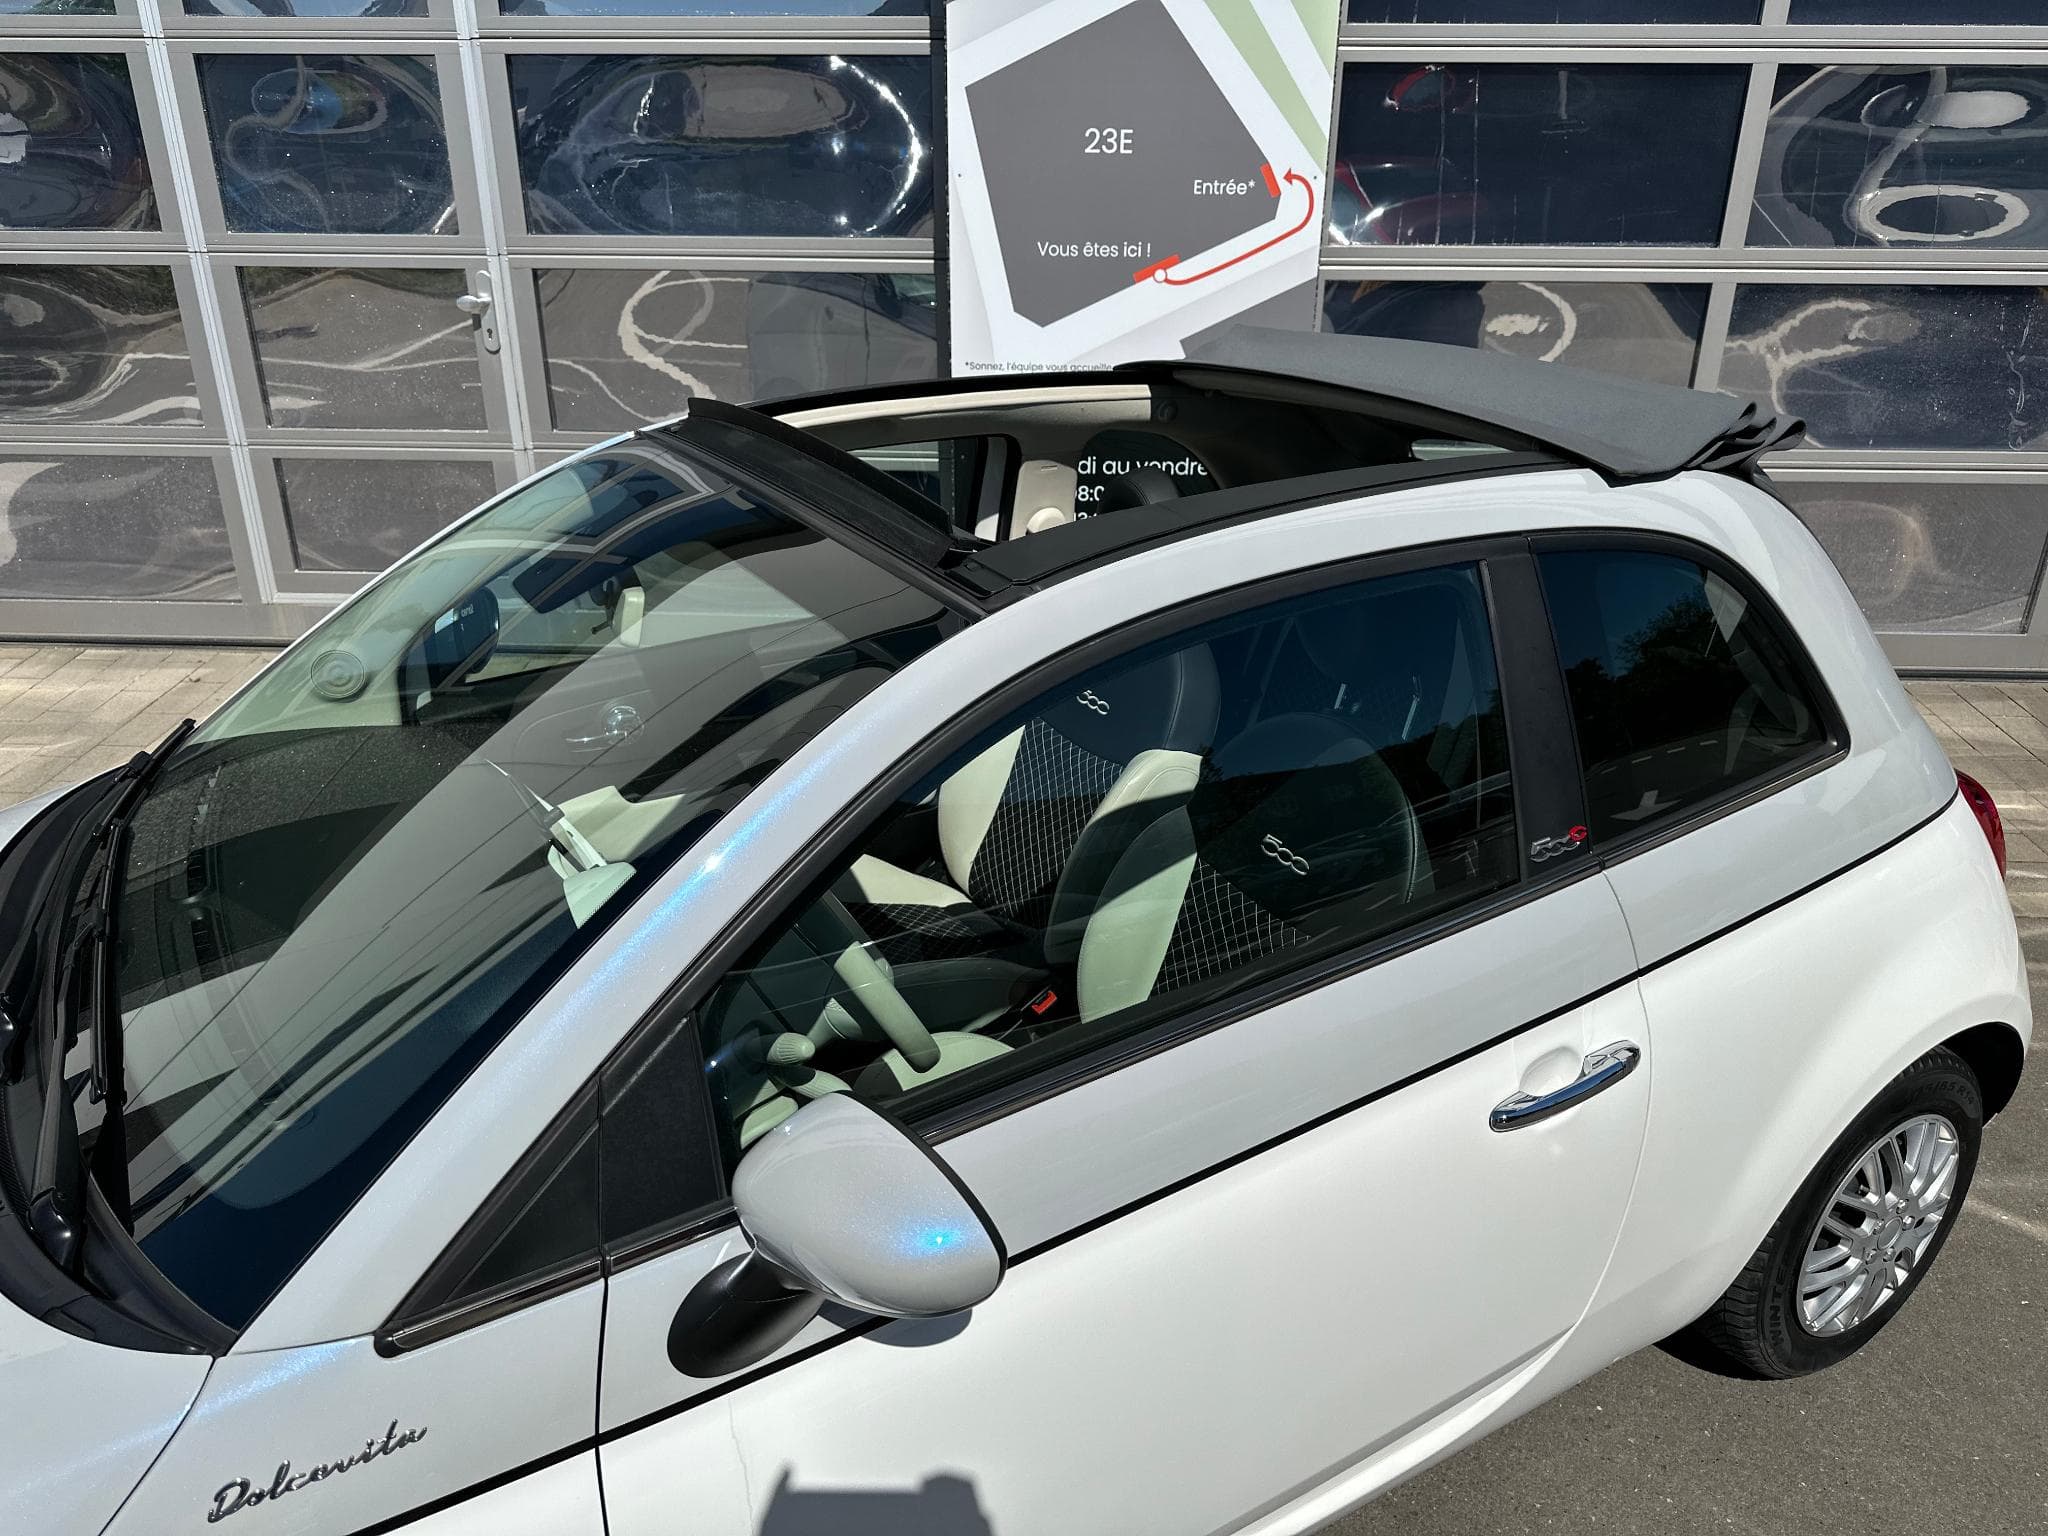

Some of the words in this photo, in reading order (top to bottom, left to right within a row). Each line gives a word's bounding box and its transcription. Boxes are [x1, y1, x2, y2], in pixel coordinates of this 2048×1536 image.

[1084, 127, 1134, 154] 23E
[1037, 241, 1079, 257] Vous
[1083, 241, 1119, 258] êtes
[1123, 241, 1142, 258] ici
[1146, 242, 1151, 258] !
[1045, 363, 1068, 372] vous
[1102, 460, 1131, 475] au
[1076, 689, 1110, 715] 500
[1260, 833, 1310, 876] 500
[207, 1418, 428, 1524] Dolcevita
